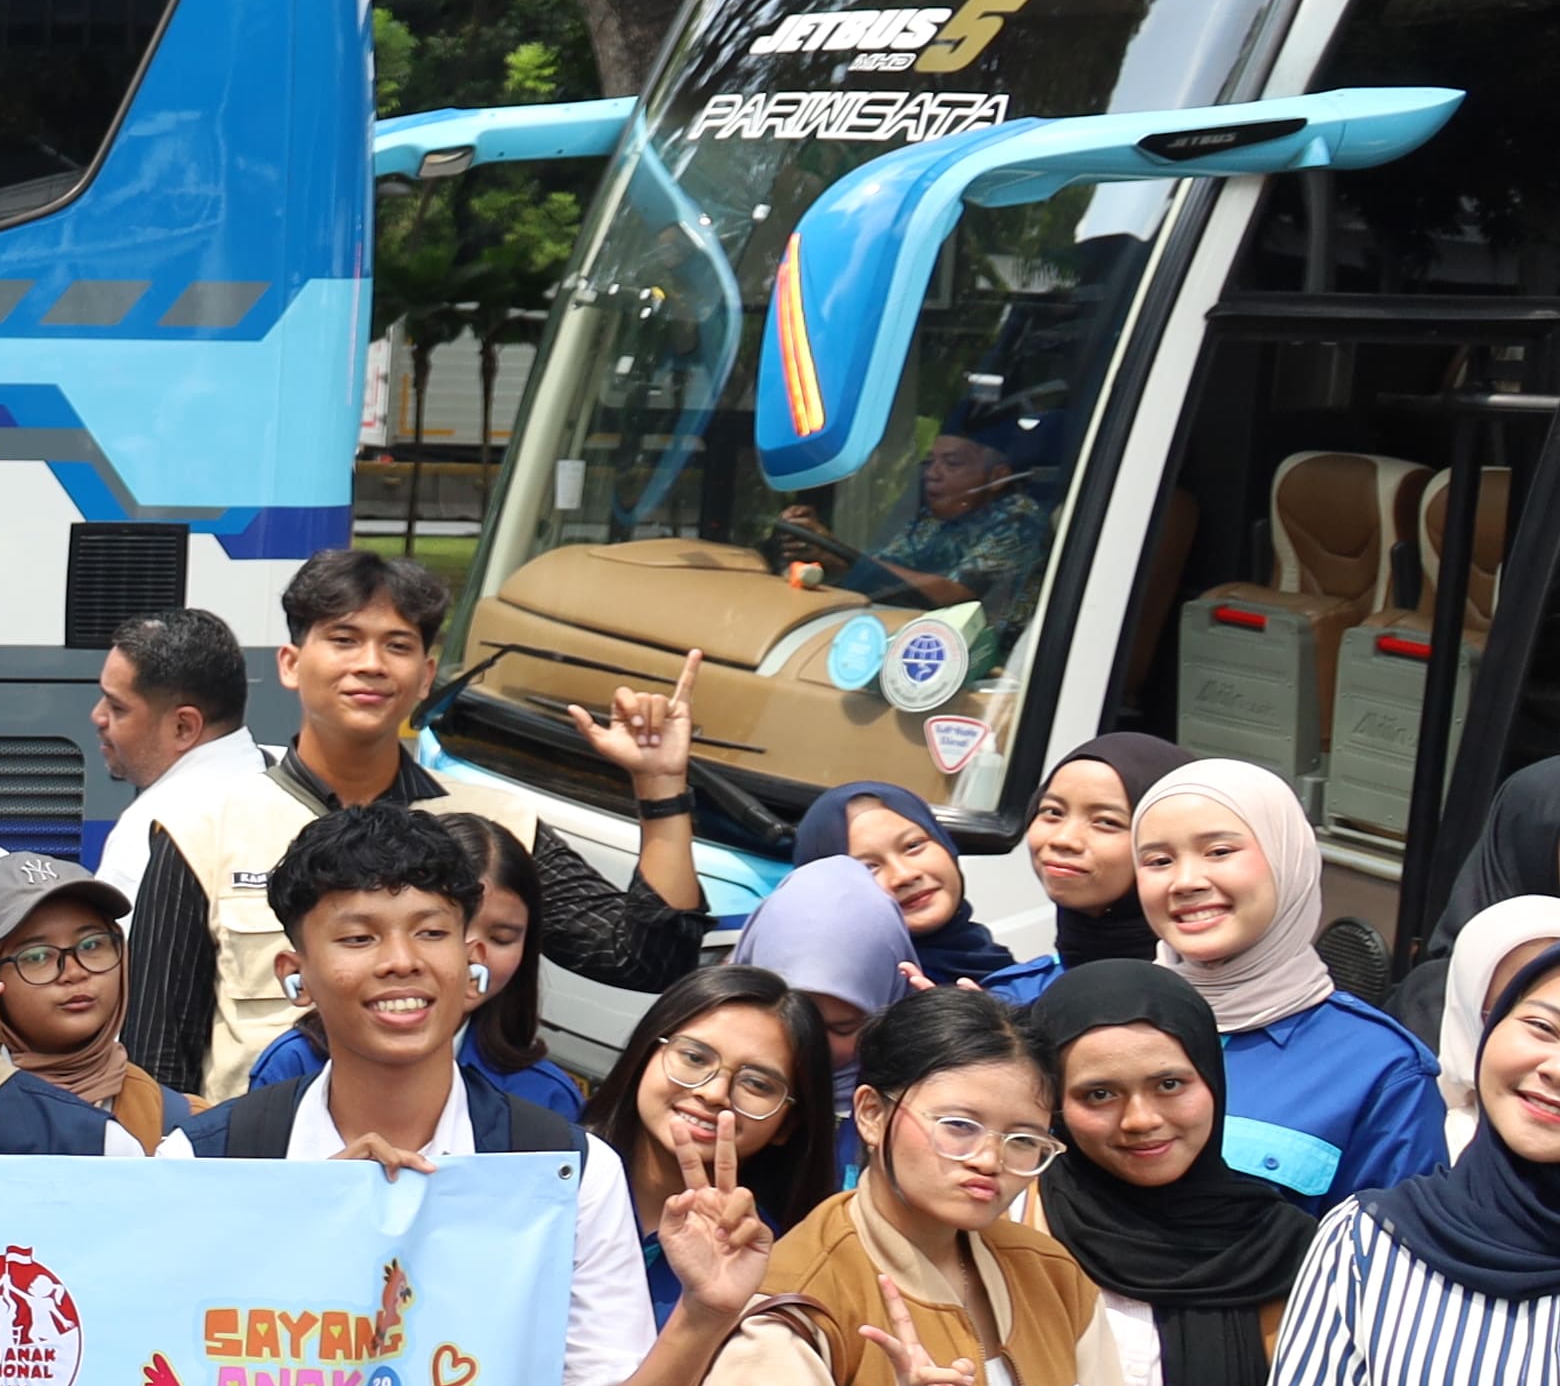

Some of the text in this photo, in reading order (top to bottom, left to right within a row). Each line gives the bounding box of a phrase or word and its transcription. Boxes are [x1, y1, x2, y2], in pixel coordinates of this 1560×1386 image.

[750, 8, 952, 55] JETBUS
[688, 91, 1010, 141] PARIWISATA
[1166, 131, 1238, 149] JETBUS
[4, 1347, 57, 1363] ANAK
[204, 1308, 403, 1361] SAYANG
